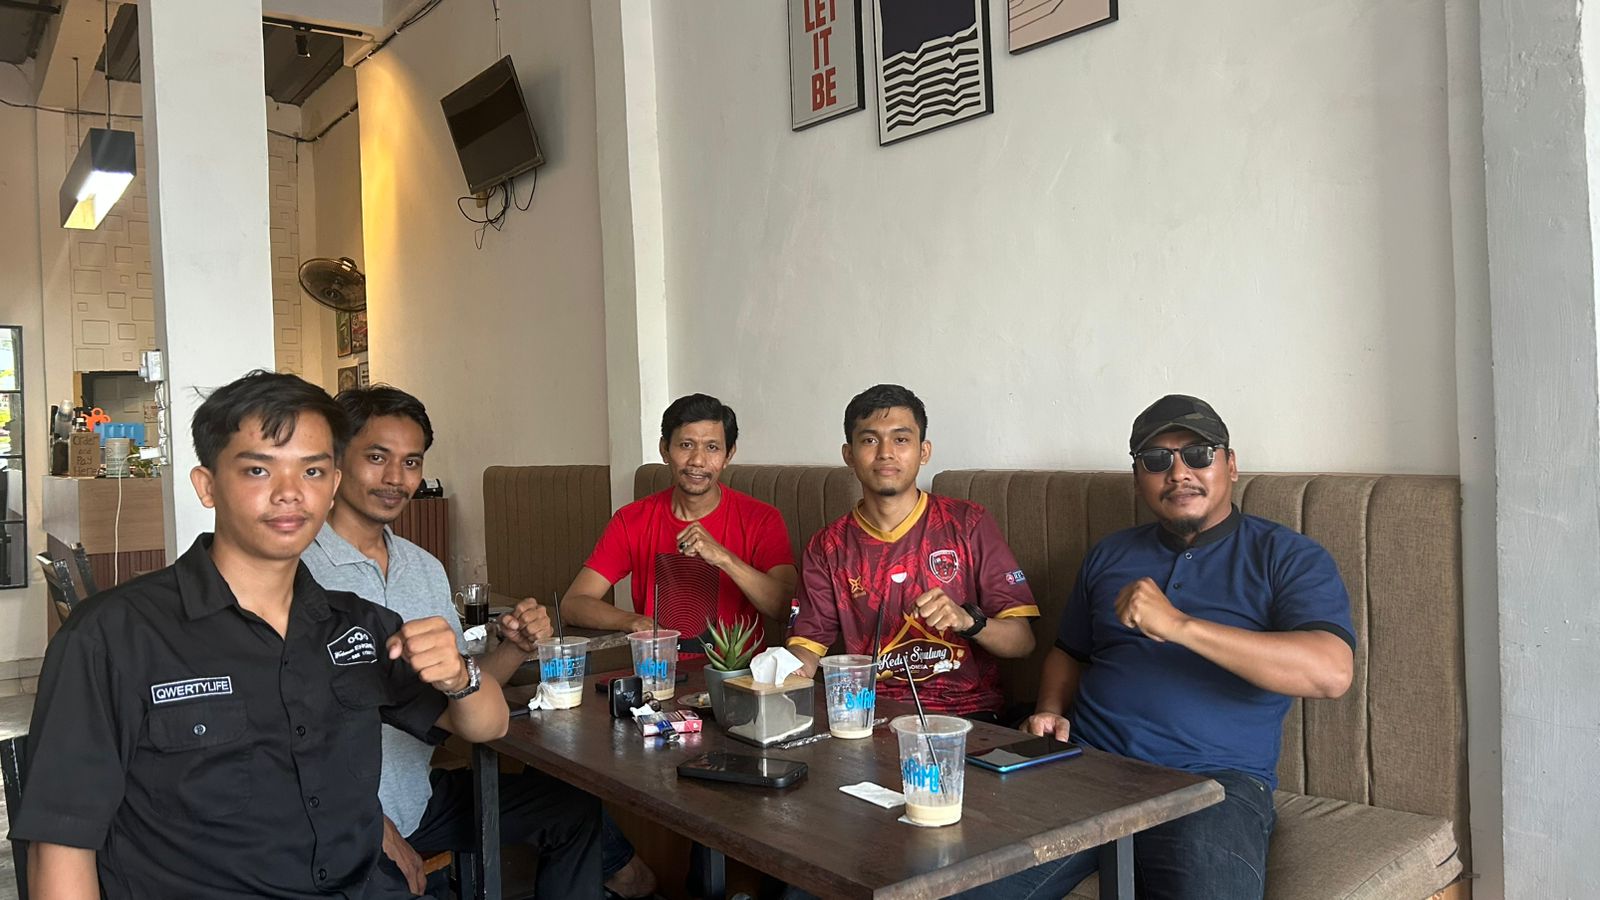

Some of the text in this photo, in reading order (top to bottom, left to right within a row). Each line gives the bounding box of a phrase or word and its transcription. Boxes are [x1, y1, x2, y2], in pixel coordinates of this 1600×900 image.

[804, 0, 836, 33] LET
[812, 26, 832, 70] IT
[811, 67, 837, 112] BE
[156, 680, 229, 699] QWERTYLIFE
